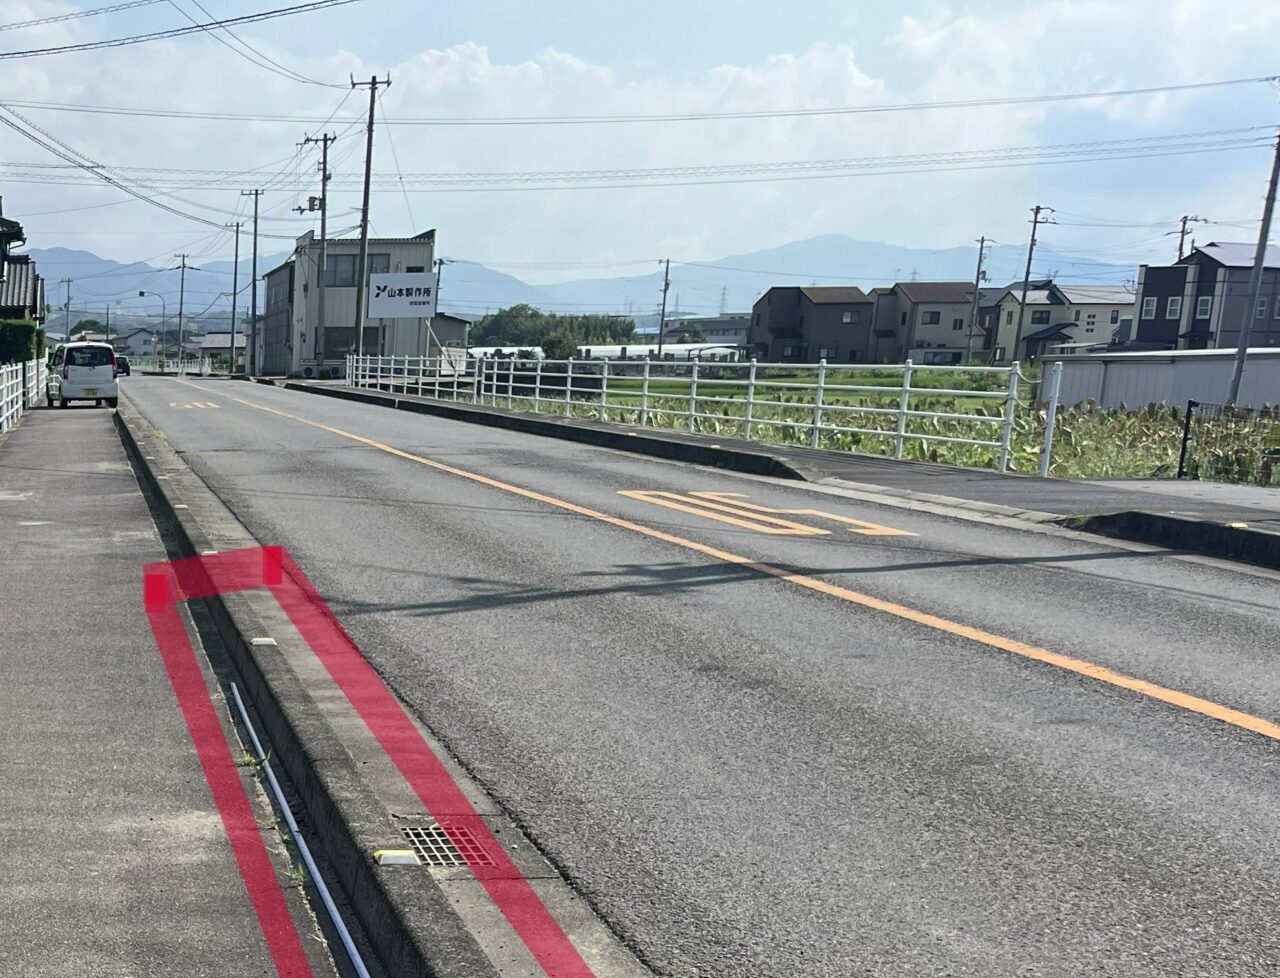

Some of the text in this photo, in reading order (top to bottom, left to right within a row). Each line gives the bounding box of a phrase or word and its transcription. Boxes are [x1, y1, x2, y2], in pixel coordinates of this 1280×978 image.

[387, 287, 432, 298] 山本製作所
